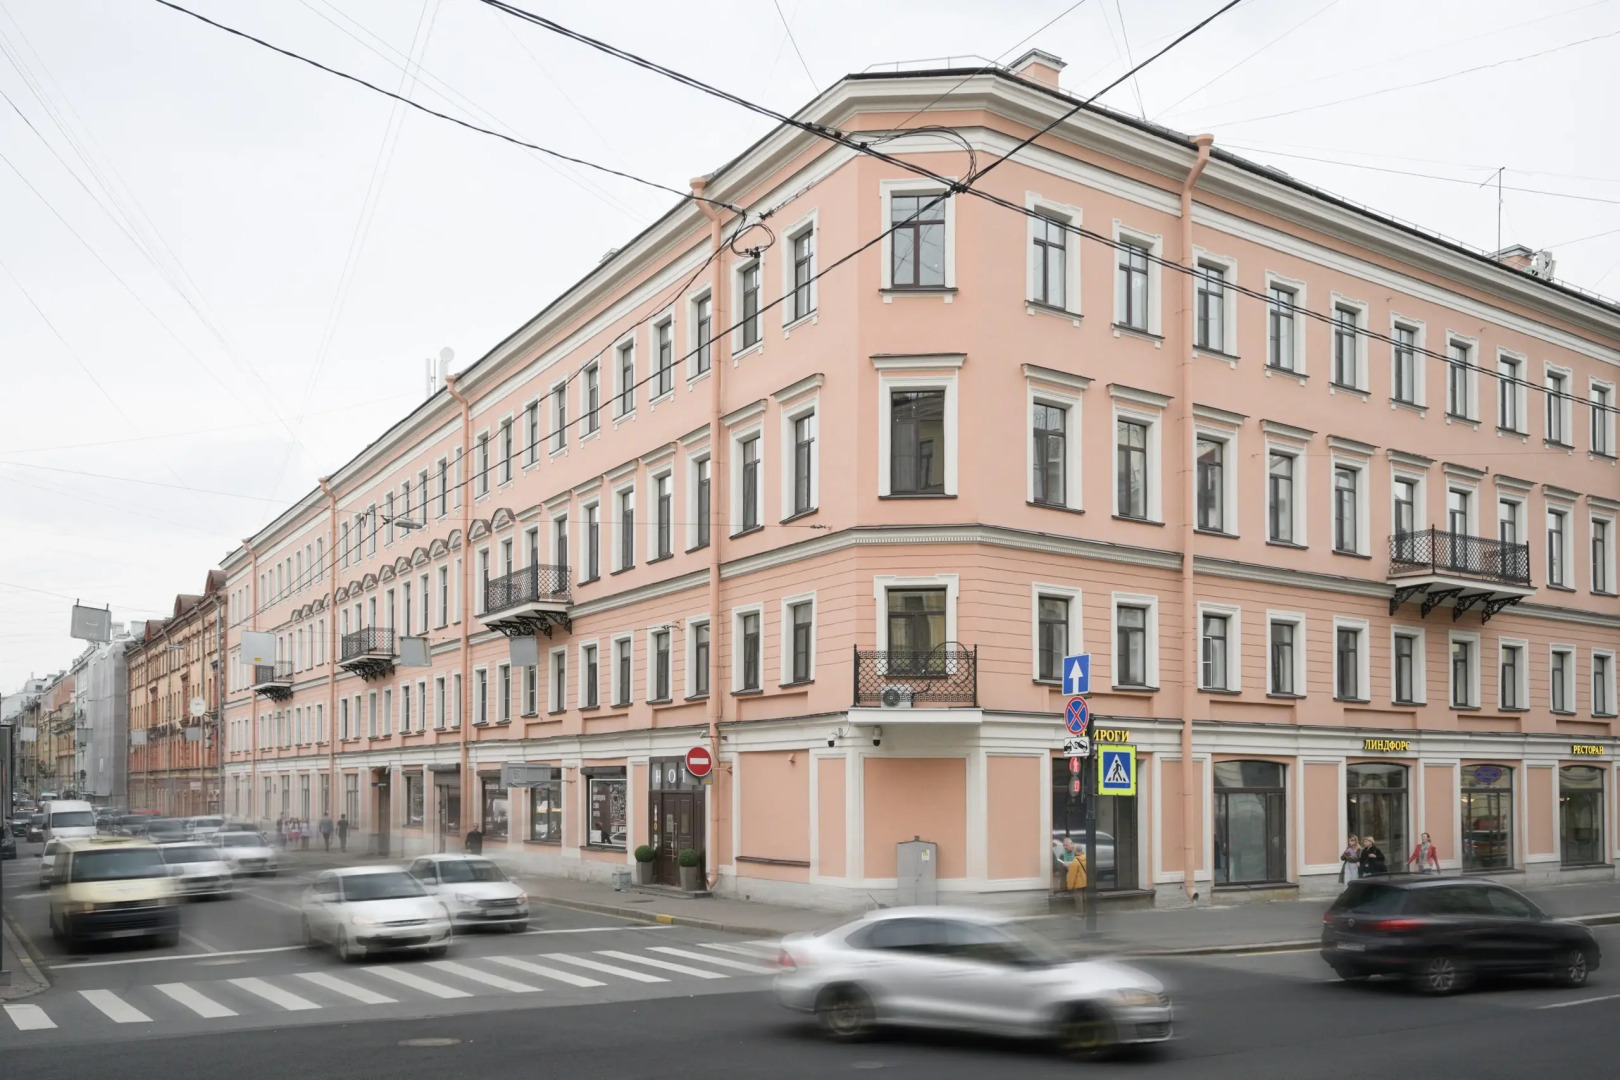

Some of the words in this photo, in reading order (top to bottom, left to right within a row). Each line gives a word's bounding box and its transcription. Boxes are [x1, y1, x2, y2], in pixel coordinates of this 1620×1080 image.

[1364, 739, 1411, 752] ЛИНДФОРС
[1573, 744, 1604, 755] РЕСТОРАН
[655, 768, 686, 784] HOT
